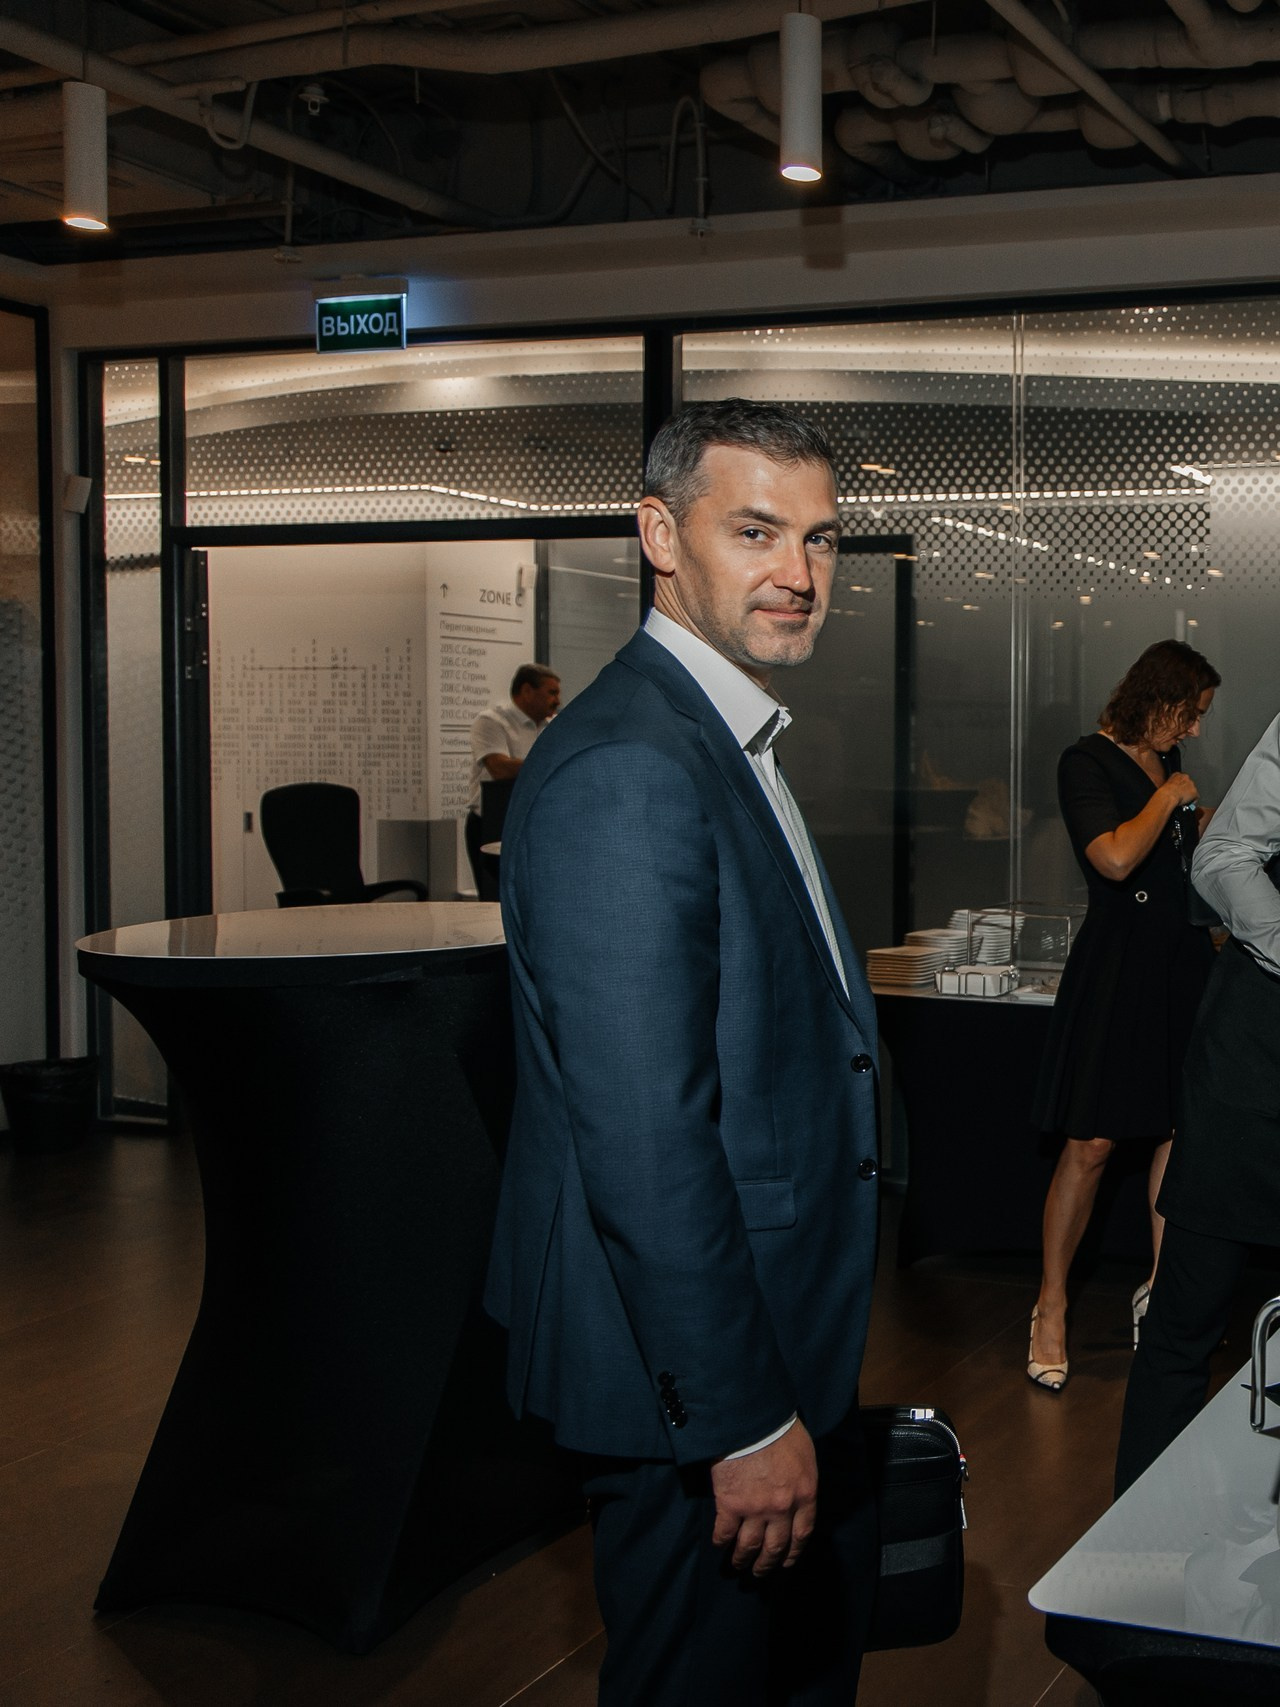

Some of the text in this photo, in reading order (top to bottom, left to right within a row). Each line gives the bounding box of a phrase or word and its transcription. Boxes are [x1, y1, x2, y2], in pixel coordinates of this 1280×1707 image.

[322, 312, 399, 337] ВЫХОД
[479, 588, 523, 607] ZONE C
